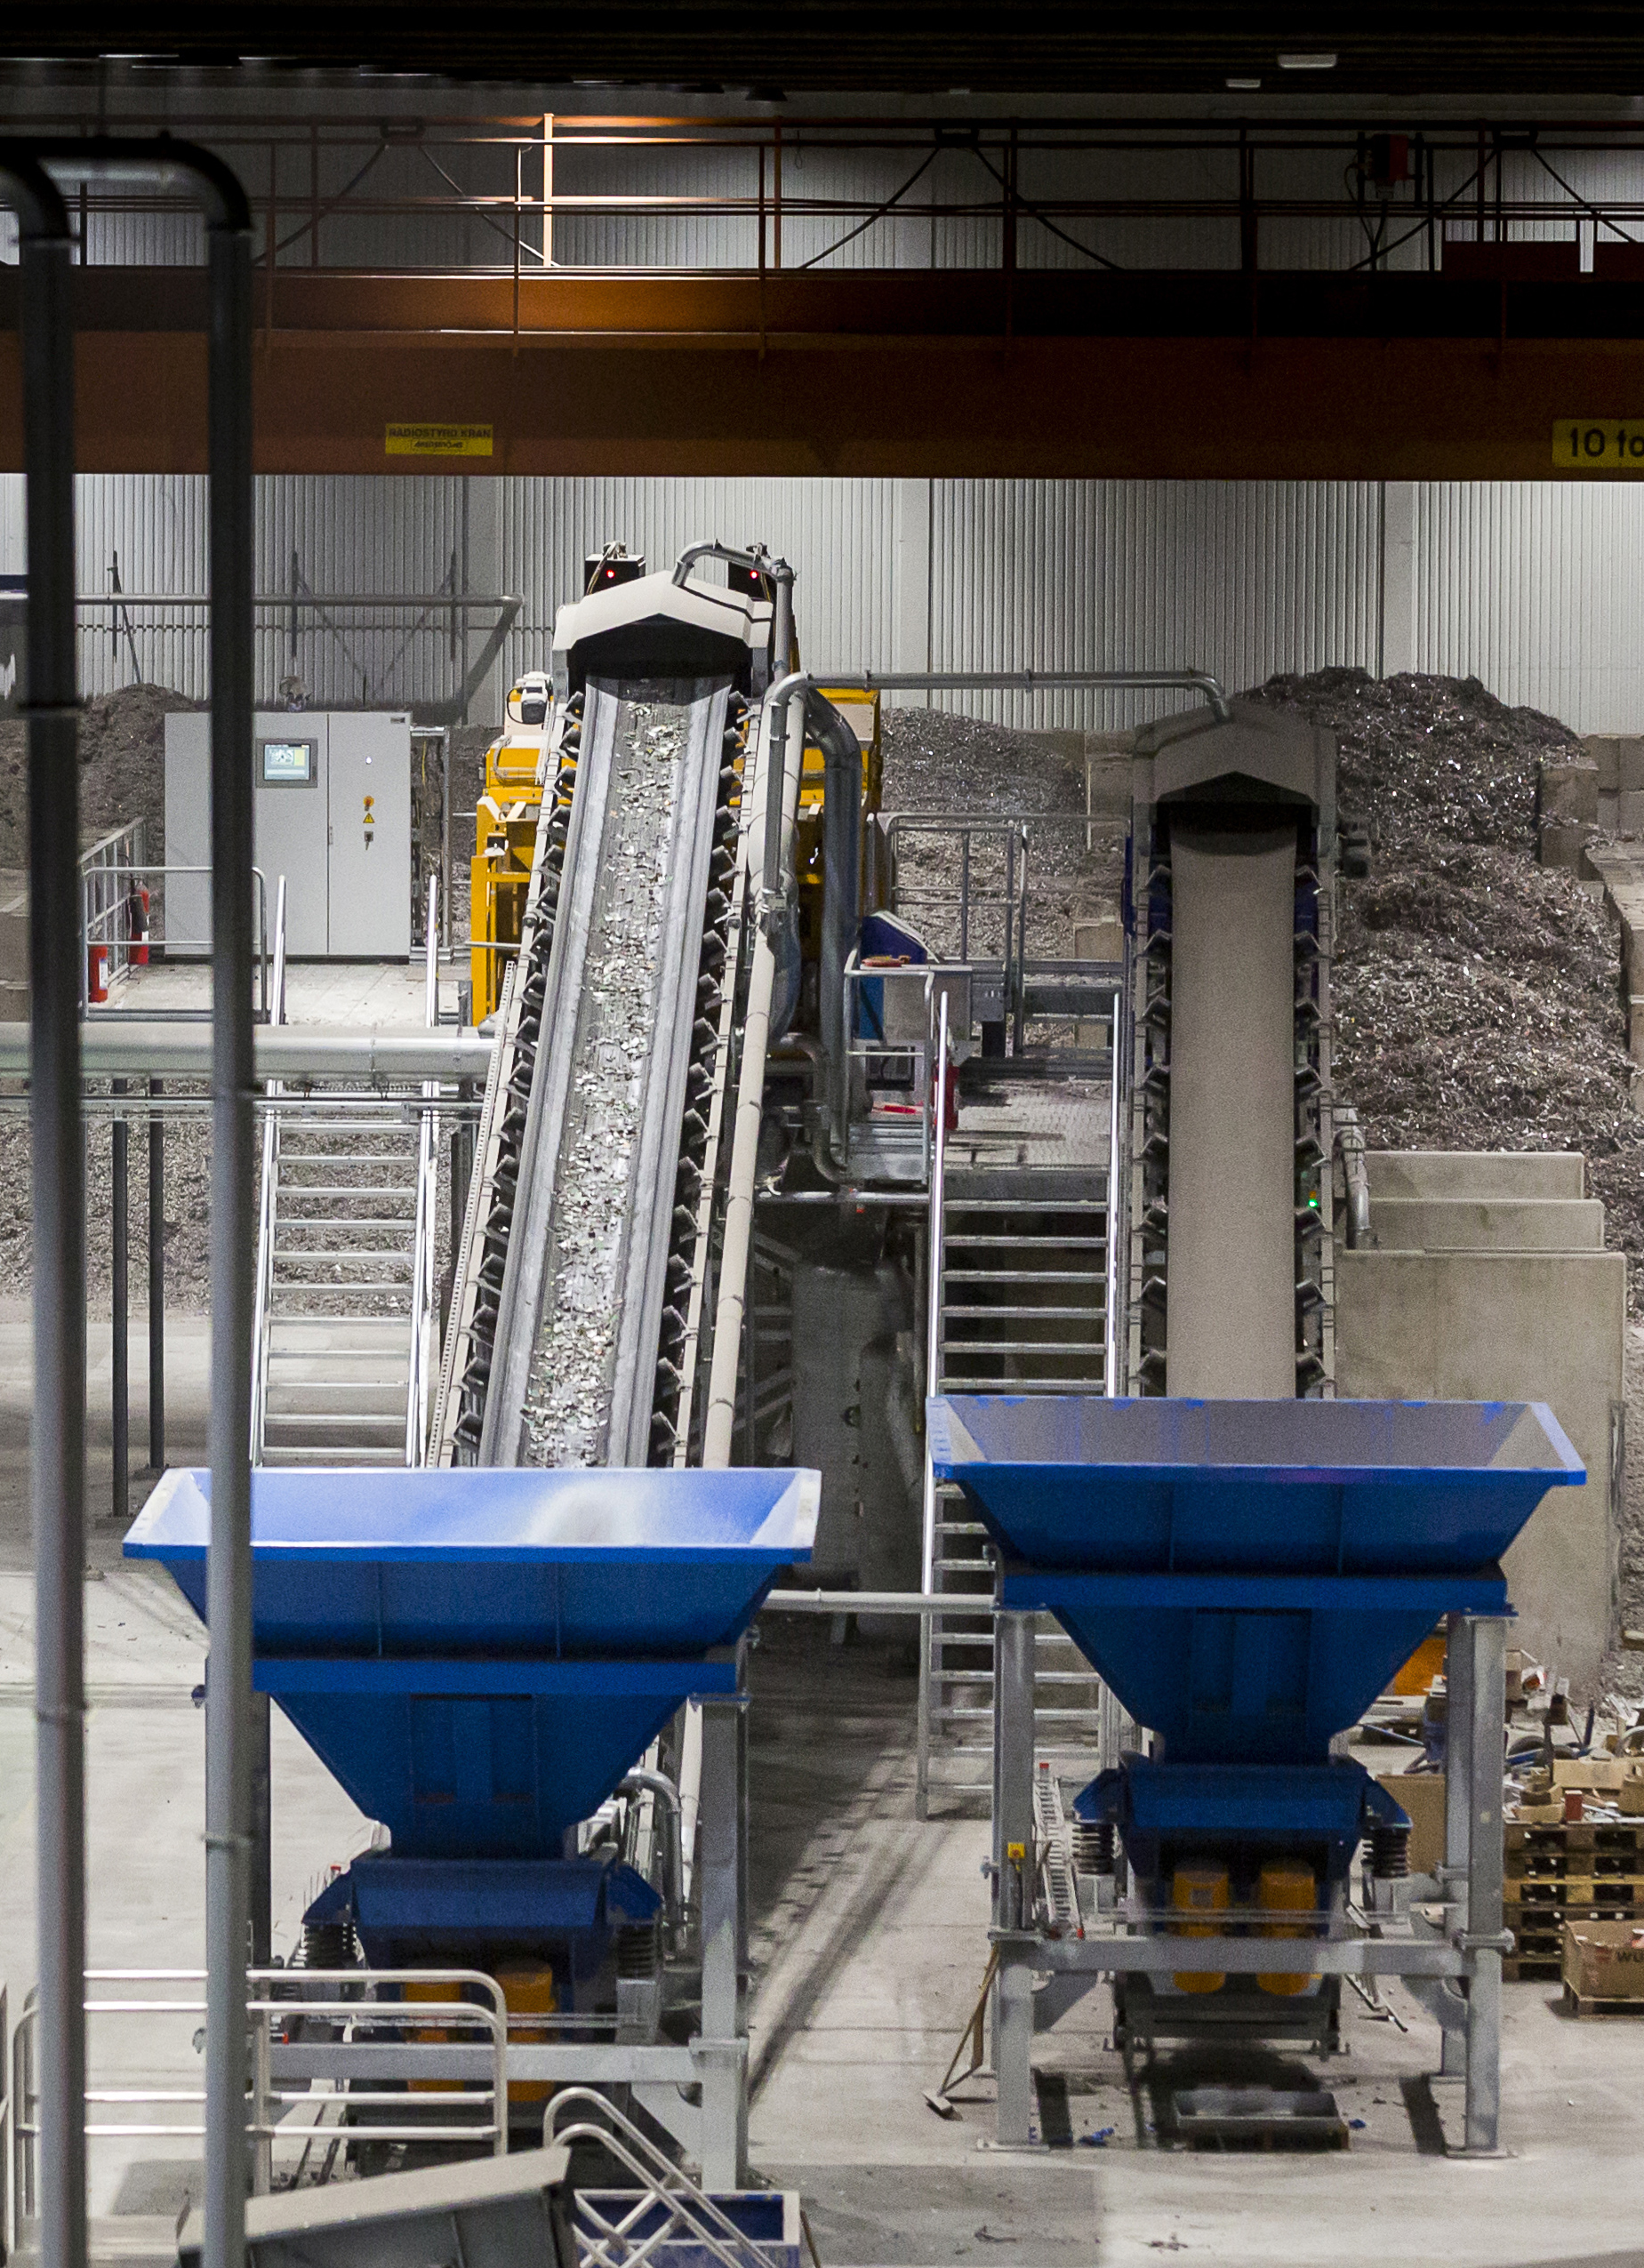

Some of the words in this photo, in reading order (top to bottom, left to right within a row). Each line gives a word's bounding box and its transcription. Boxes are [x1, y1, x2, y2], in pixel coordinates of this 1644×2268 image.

[389, 428, 457, 437] RADIOSTYRD
[461, 429, 491, 437] KRAN
[1570, 428, 1605, 457] 10
